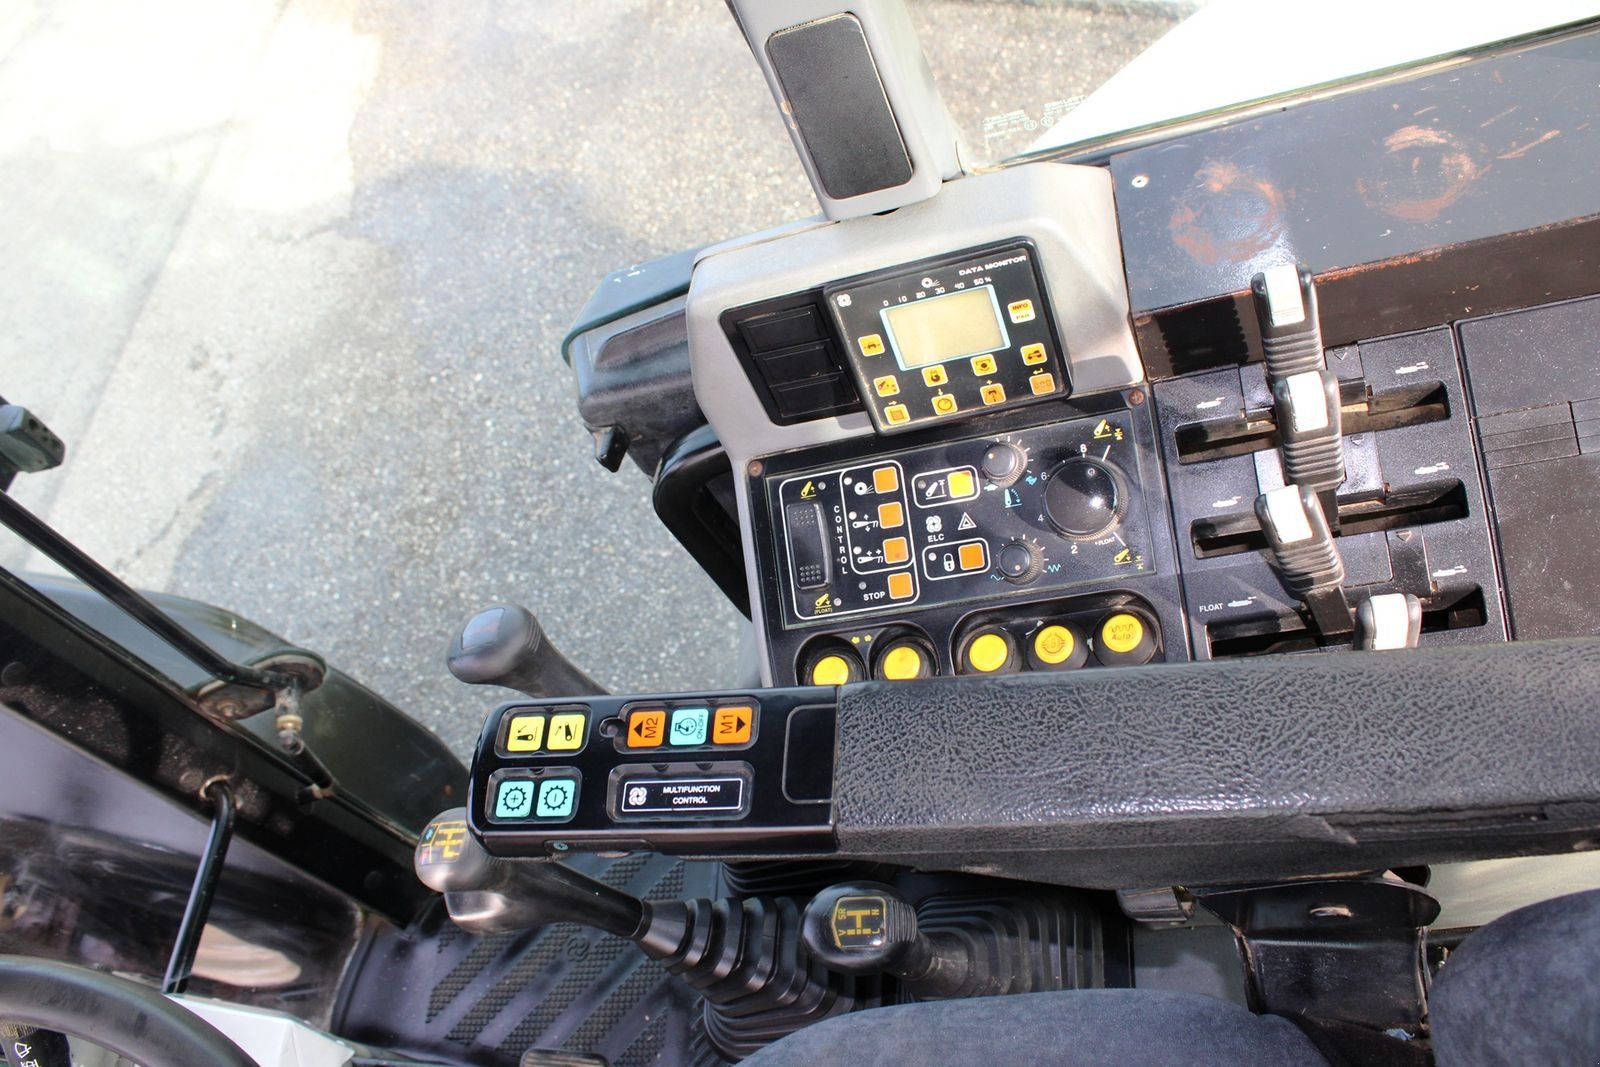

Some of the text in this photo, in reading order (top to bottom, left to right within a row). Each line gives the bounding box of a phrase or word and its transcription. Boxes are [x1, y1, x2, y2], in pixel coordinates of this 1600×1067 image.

[958, 255, 1027, 276] DATA MONITOR
[898, 295, 908, 304] 10
[915, 291, 926, 300] 20
[934, 286, 946, 296] 30
[954, 282, 965, 290] 40
[973, 277, 984, 286] 50
[1012, 302, 1028, 311] INFO
[1079, 443, 1087, 453] 8
[1040, 471, 1047, 481] 6
[1037, 514, 1044, 522] 4
[833, 504, 848, 575] CONTROL
[927, 533, 945, 543] ELC
[1071, 545, 1078, 554] 2
[863, 591, 886, 601] STOP
[1199, 603, 1224, 612] FLOAT
[644, 717, 658, 739] M2
[720, 714, 734, 735] M1
[662, 784, 721, 794] MULTIFUNCTION
[672, 796, 708, 805] CONTROL
